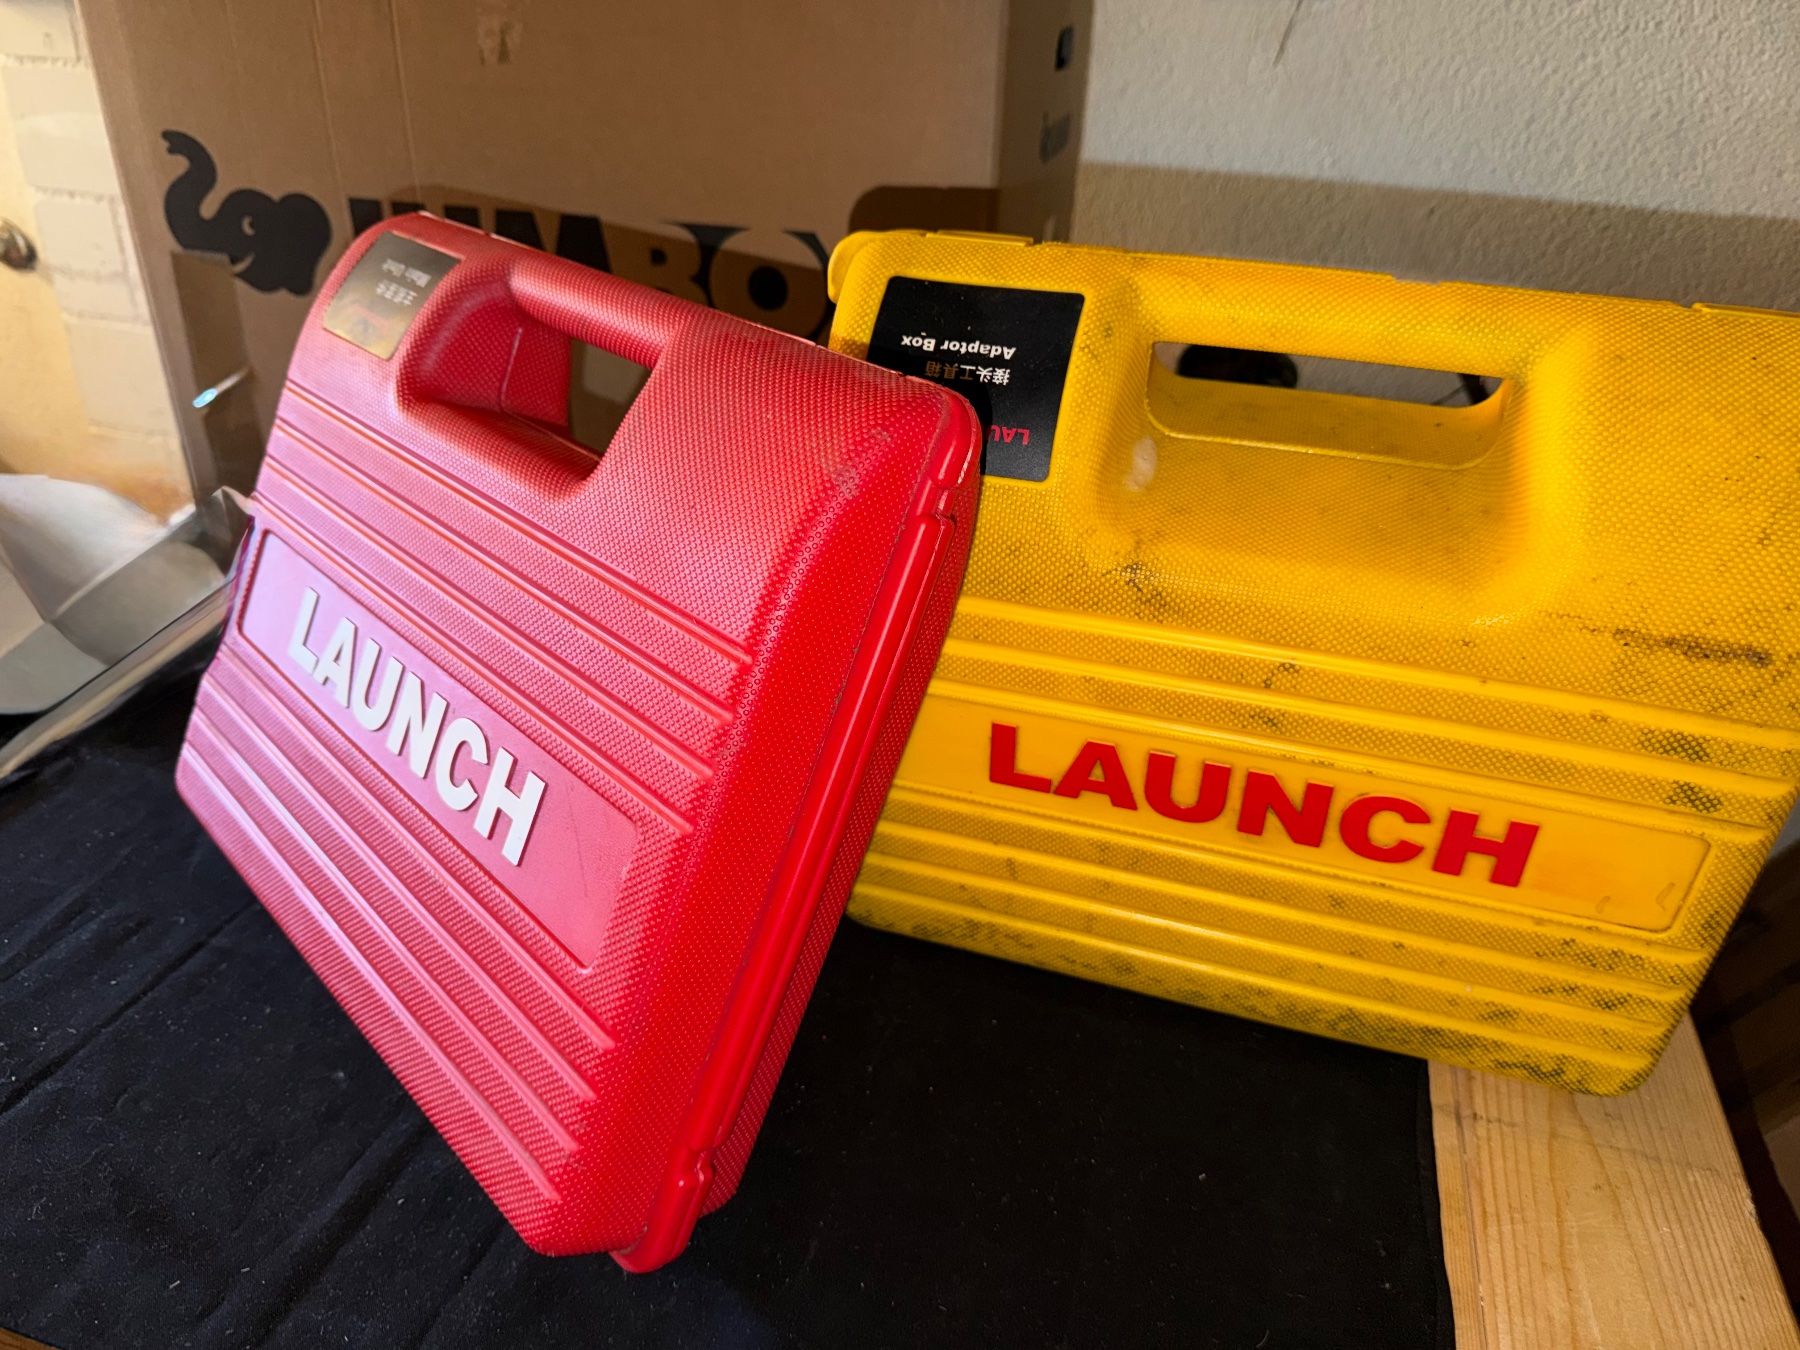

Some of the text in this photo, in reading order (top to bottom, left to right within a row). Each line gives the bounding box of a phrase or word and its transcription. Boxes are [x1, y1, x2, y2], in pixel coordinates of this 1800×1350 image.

[901, 335, 1016, 360] Adaptor Box
[926, 361, 1011, 385] 接头工具箱
[288, 585, 548, 867] LAUNCH
[989, 722, 1541, 888] LAUNCH
